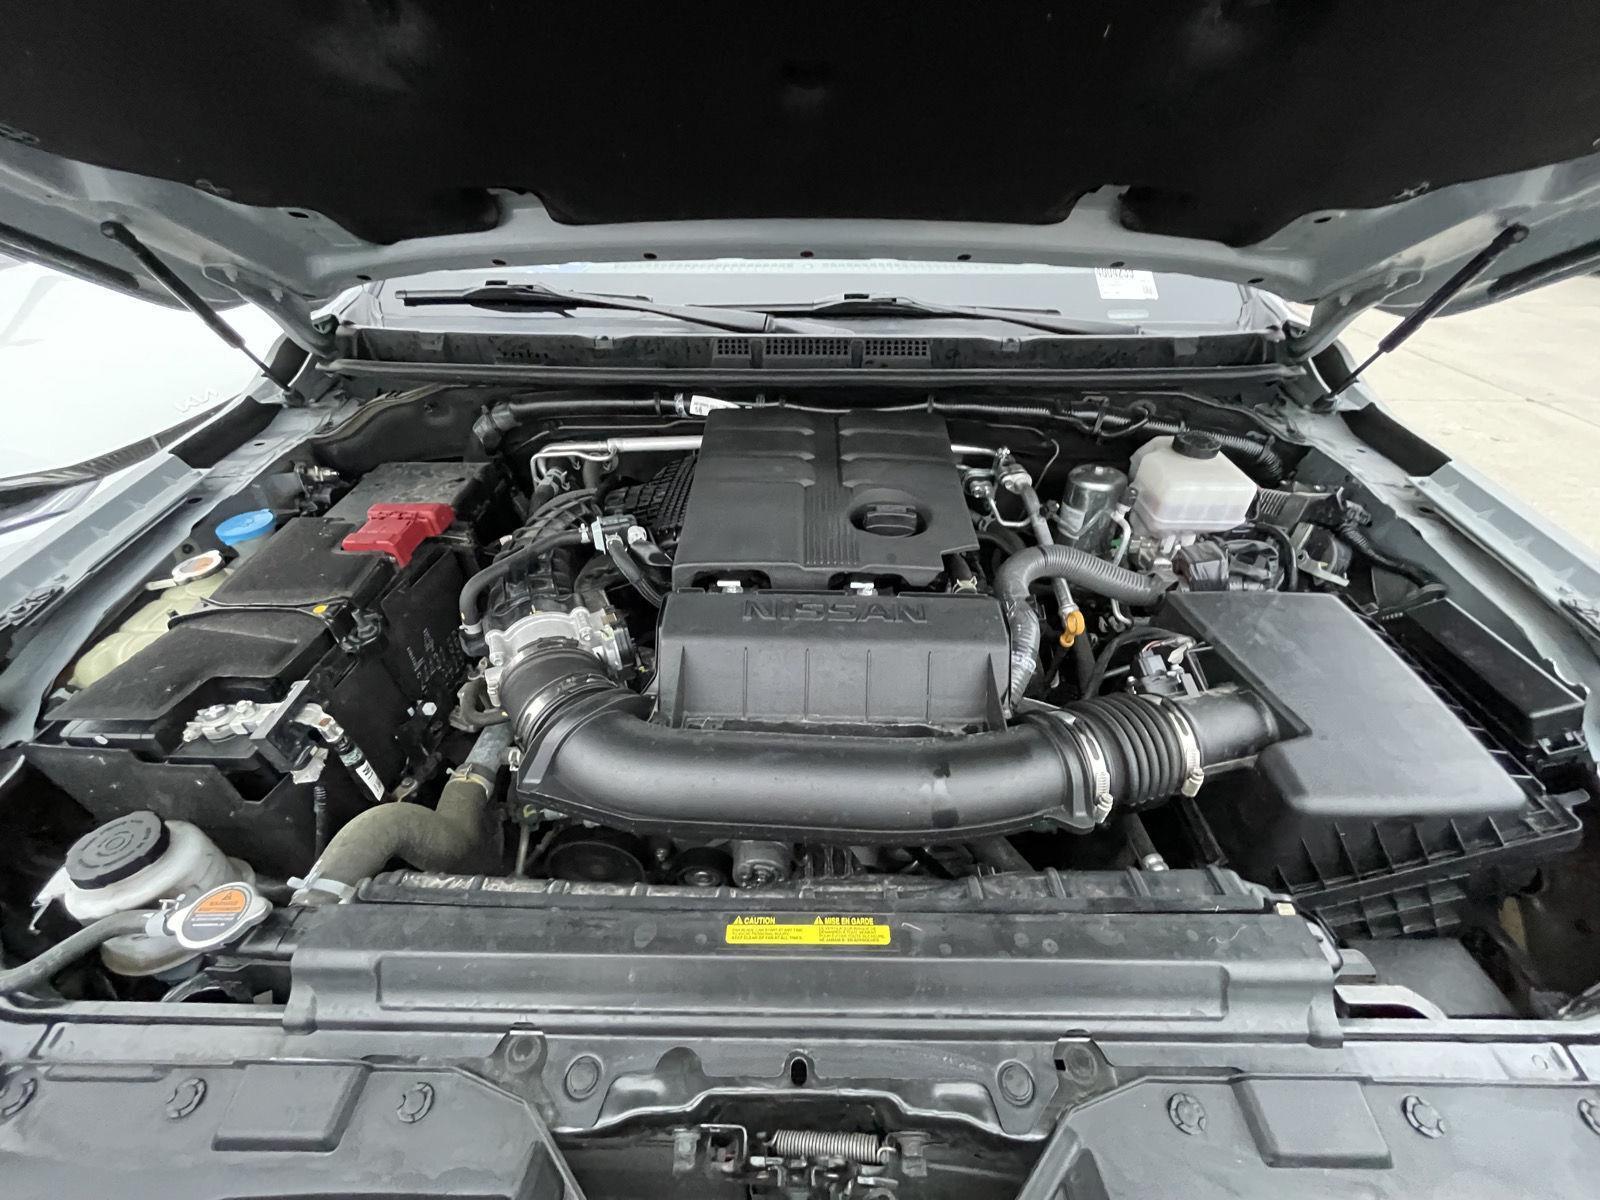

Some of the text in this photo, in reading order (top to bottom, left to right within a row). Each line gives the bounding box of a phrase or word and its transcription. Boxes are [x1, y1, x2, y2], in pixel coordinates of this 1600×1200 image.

[742, 599, 928, 624] NISSAN
[744, 917, 776, 926] CAUTION
[825, 917, 874, 927] MISE EN GARDE
